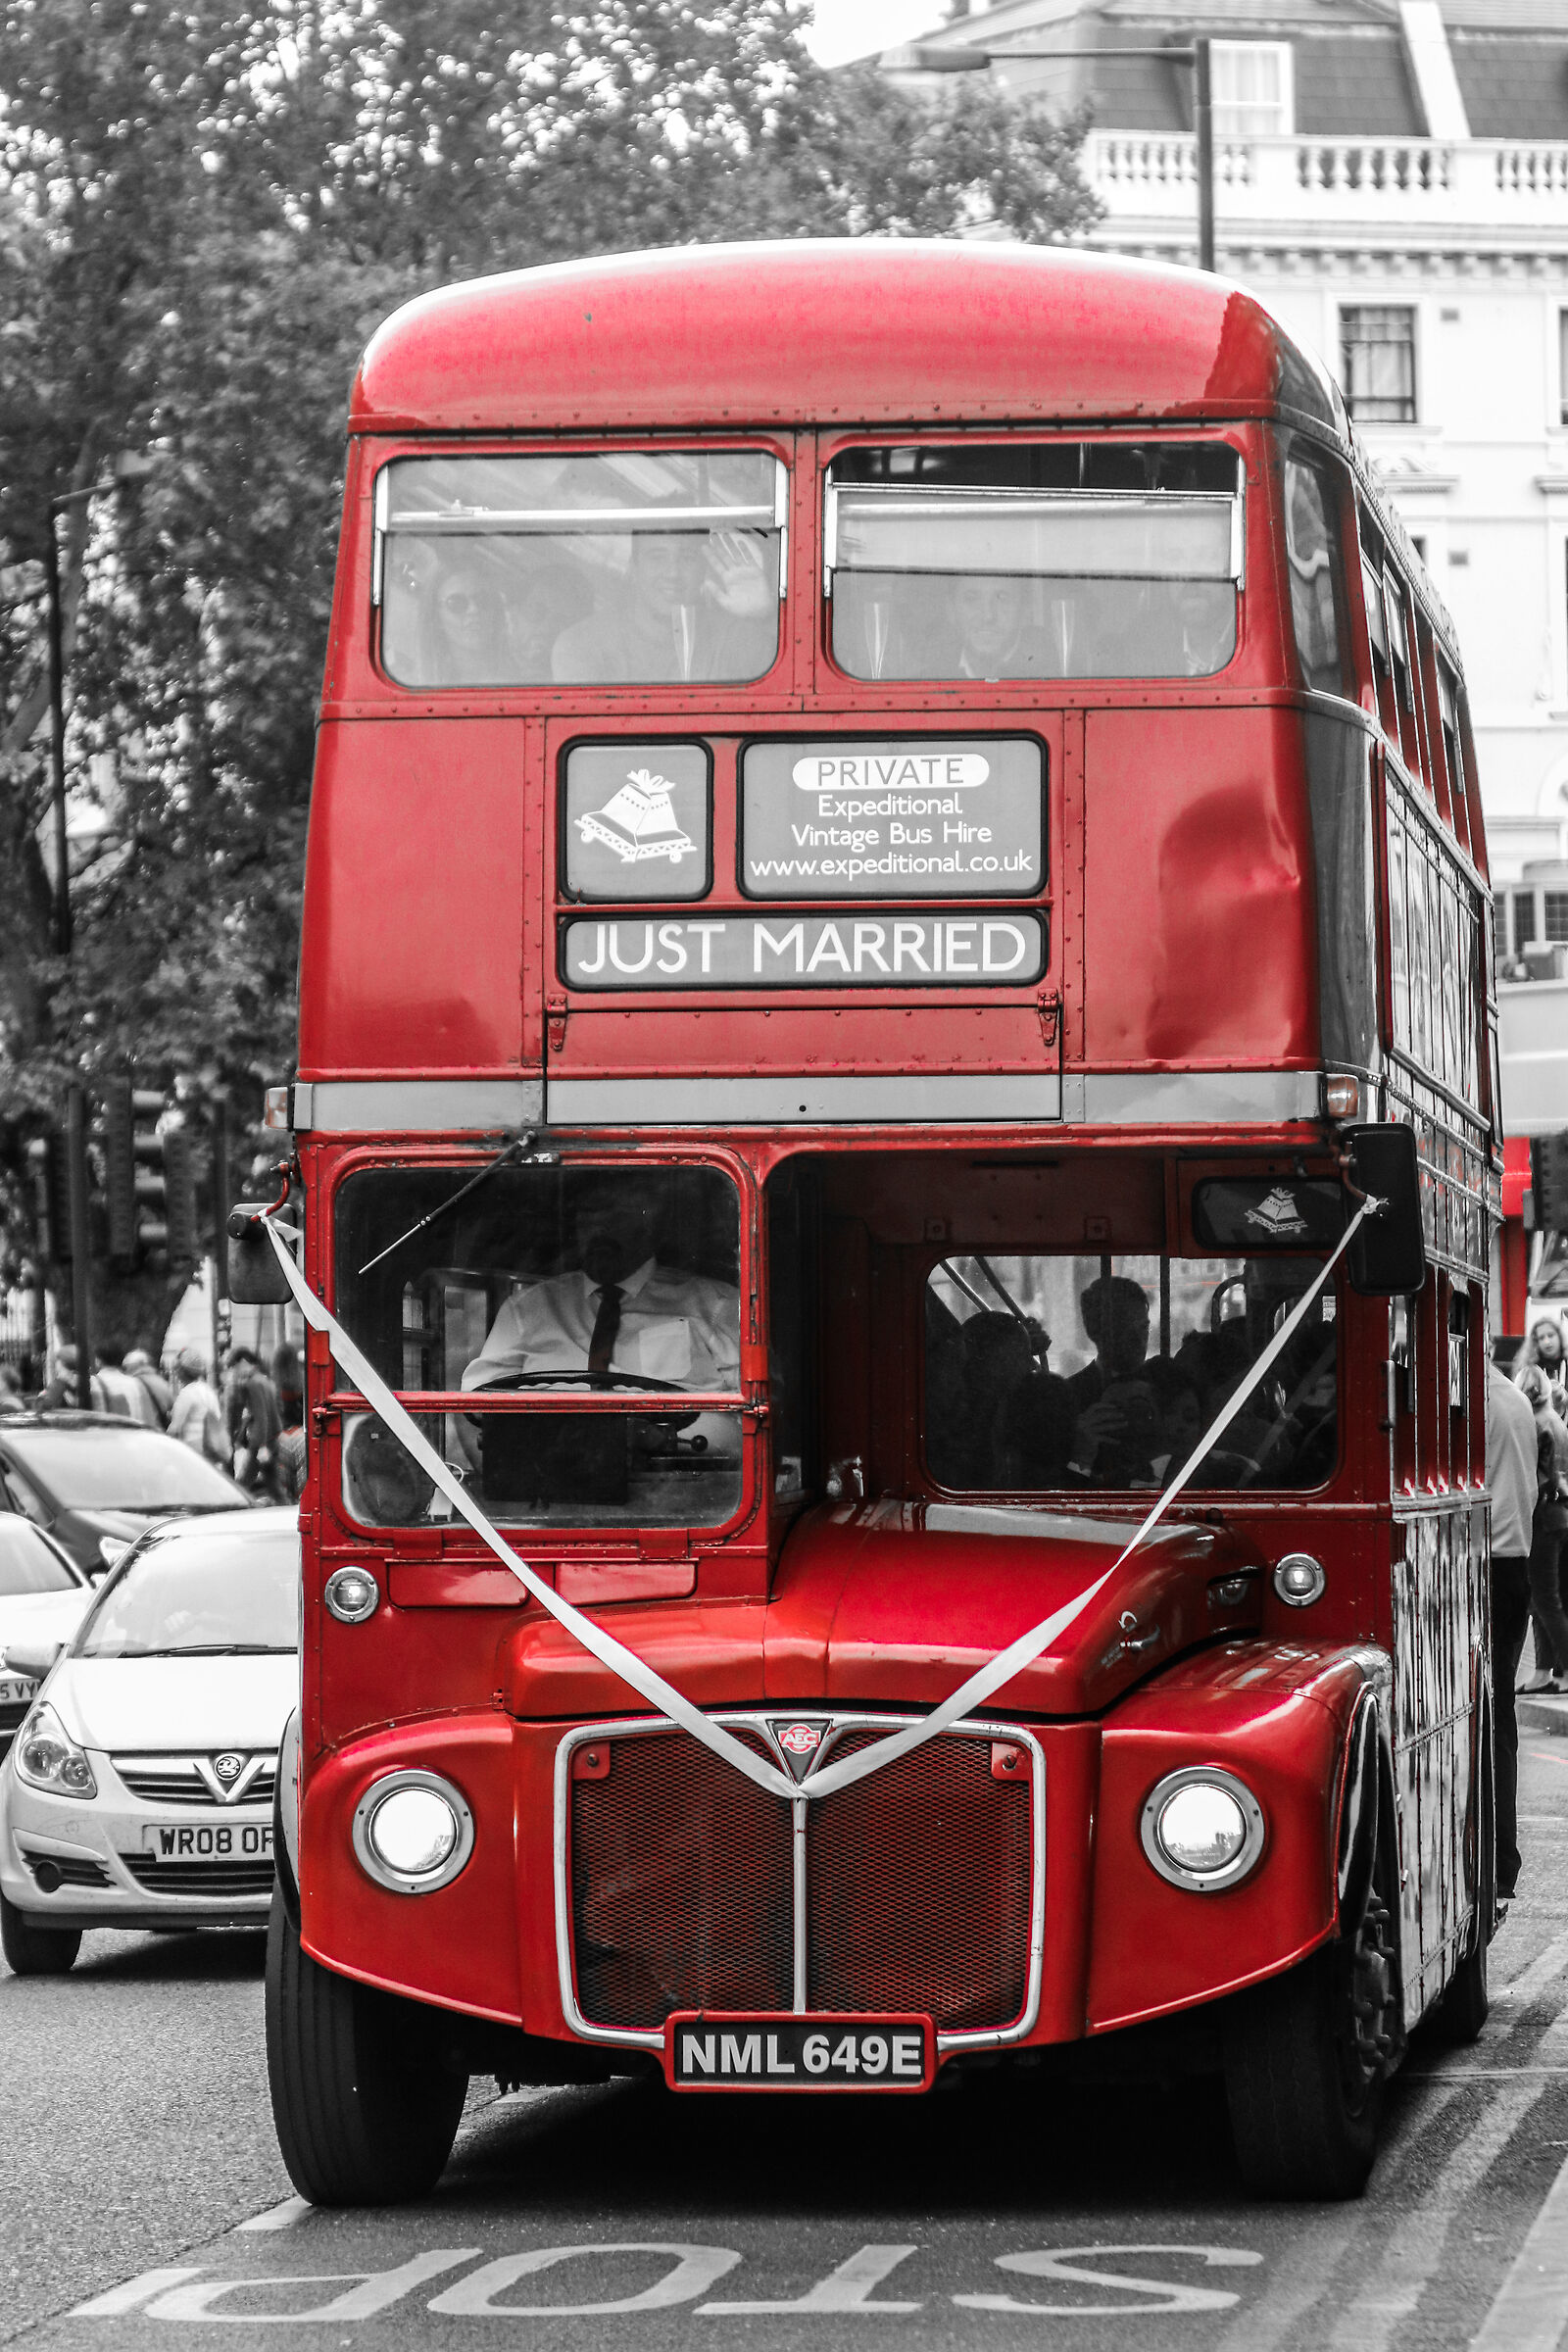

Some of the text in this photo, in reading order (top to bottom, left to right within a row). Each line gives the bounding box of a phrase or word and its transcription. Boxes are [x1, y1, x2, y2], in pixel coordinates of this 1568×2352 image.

[817, 758, 964, 786] PRIVATE
[817, 792, 963, 821] Expeditional
[791, 820, 993, 853] Vintage Bus Hire
[750, 850, 1033, 880] www.expeditional.co.uk
[577, 921, 1026, 974] JUST MARRIED
[781, 1732, 817, 1745] AEC
[159, 1828, 232, 1855] WR08
[682, 2034, 921, 2076] NML 649E
[65, 2242, 1263, 2322] STOP
